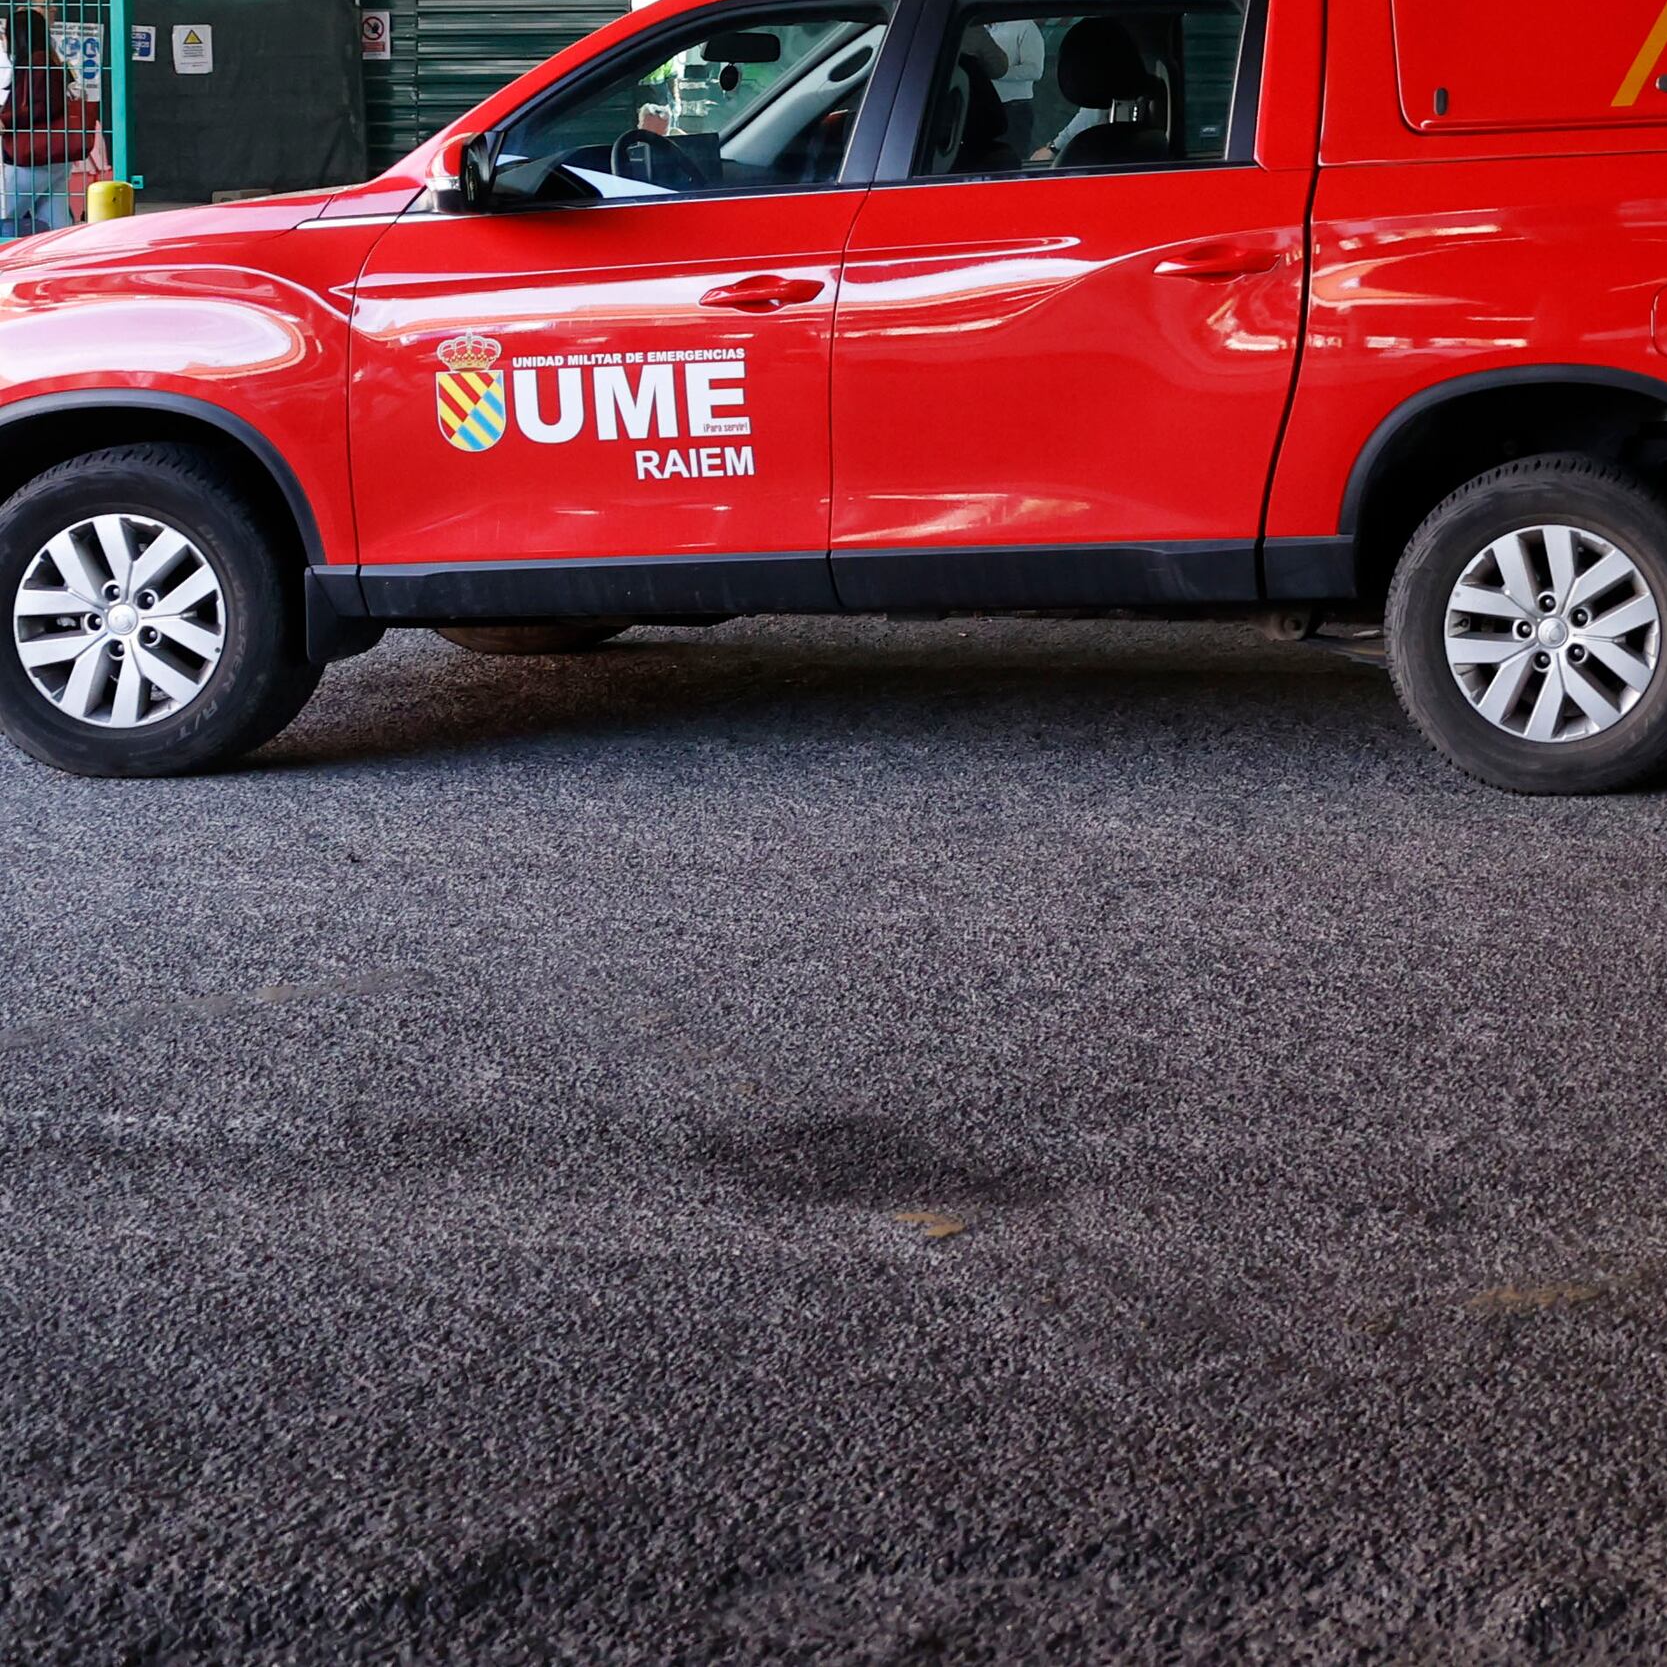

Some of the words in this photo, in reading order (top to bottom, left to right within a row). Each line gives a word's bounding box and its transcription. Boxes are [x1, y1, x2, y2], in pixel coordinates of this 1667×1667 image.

[512, 355, 564, 368] UNIDAD
[567, 352, 622, 366] MILITAR
[625, 352, 644, 363] DE
[647, 348, 746, 363] EMERGENCIAS
[512, 361, 752, 444] UME
[703, 423, 725, 434] ¡Para
[726, 422, 749, 433] servir!
[634, 446, 756, 480] RAIEM
